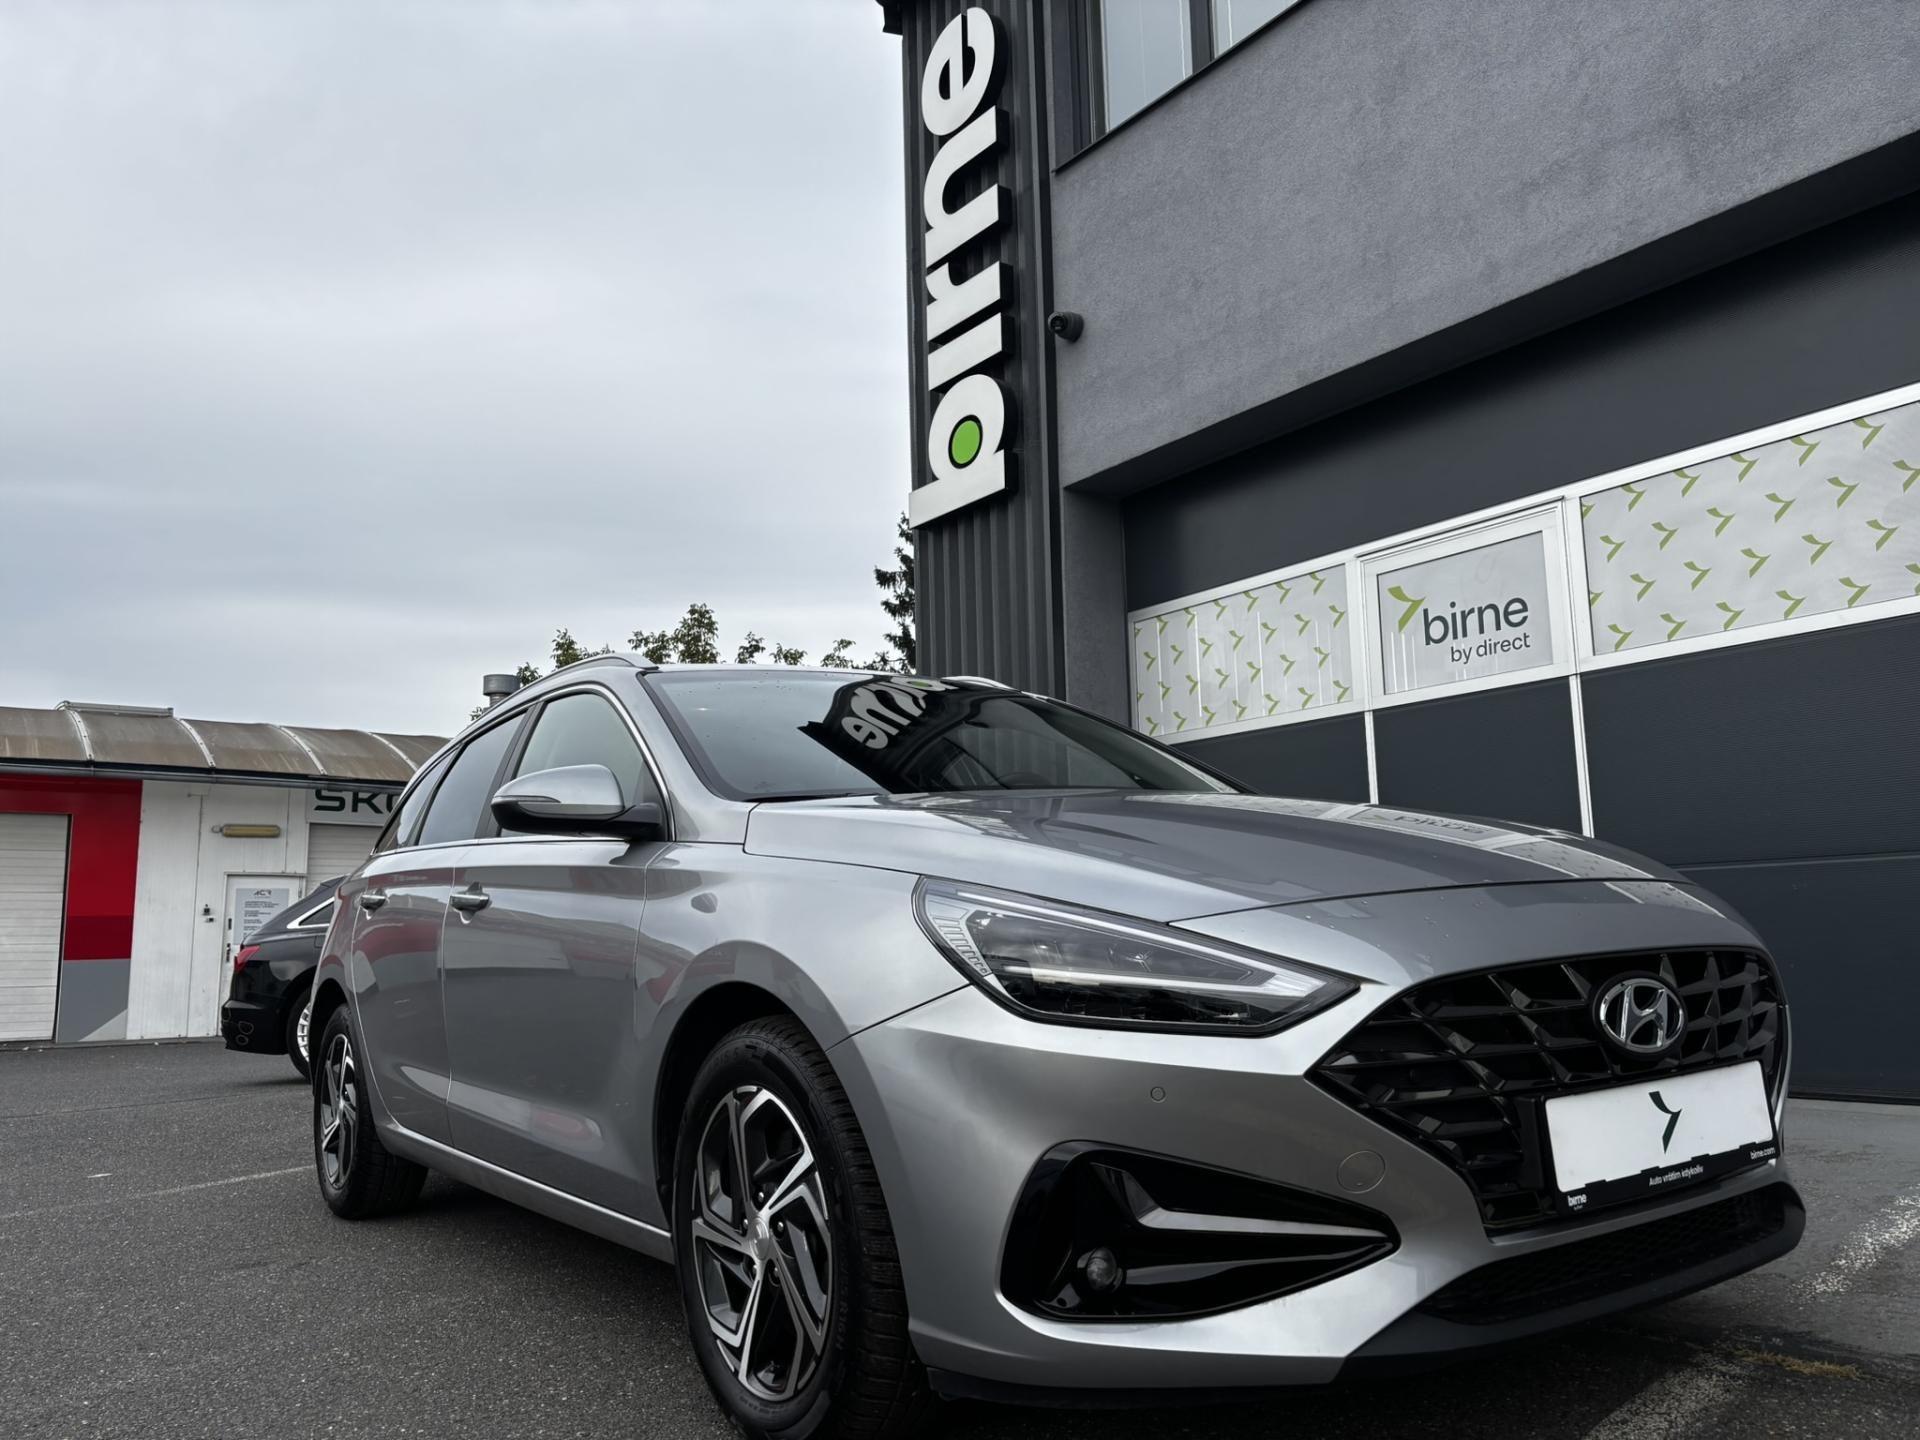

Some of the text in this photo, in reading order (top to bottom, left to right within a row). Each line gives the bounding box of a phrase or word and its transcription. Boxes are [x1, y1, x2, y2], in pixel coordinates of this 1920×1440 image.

[909, 6, 1006, 529] birne
[1423, 597, 1529, 646] birne
[1450, 632, 1531, 664] by direct
